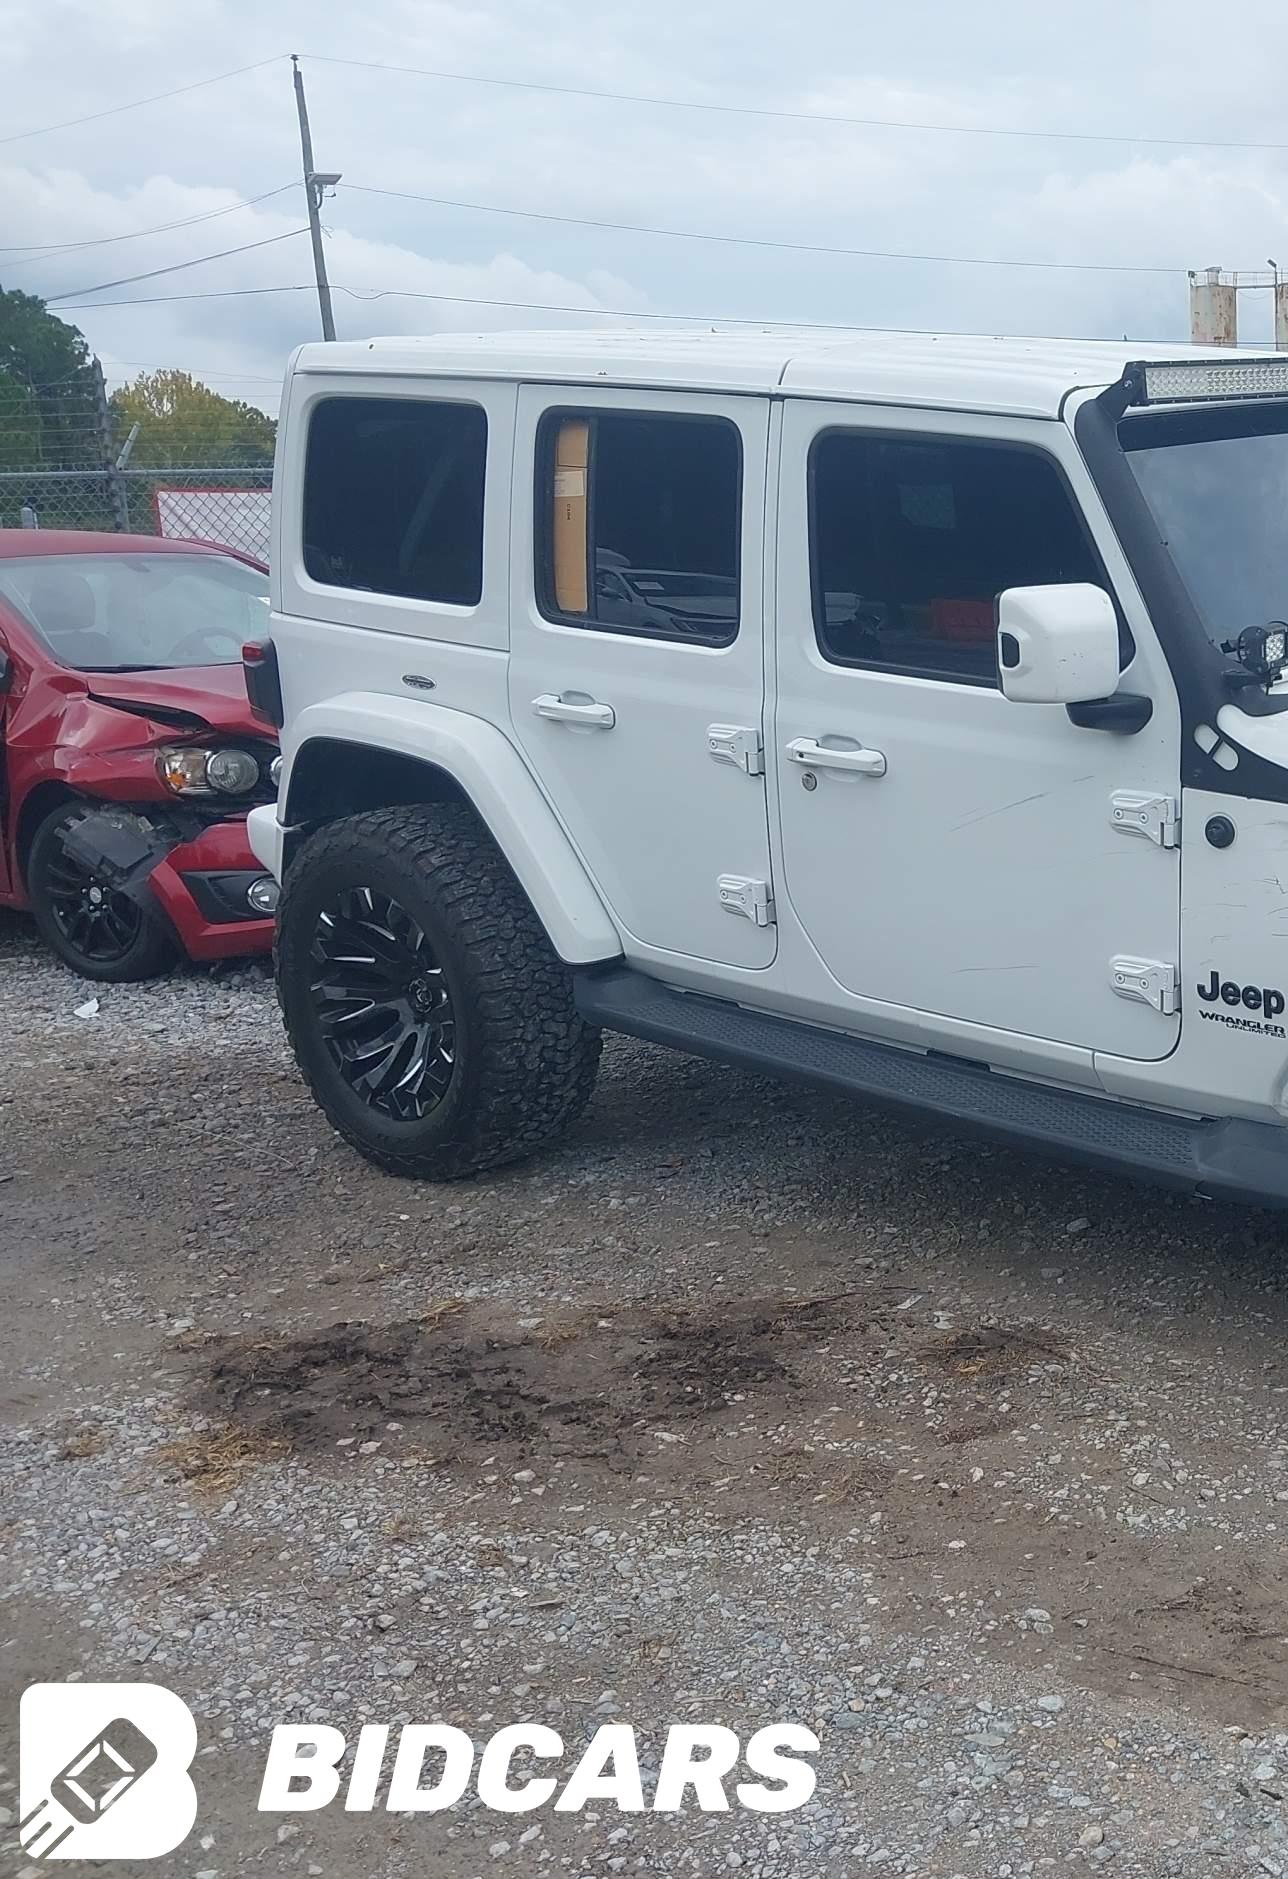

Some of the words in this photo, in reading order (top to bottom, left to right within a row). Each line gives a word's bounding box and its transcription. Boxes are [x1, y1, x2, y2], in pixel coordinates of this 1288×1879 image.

[1197, 970, 1286, 1019] Jeep
[1199, 1010, 1285, 1034] WRANGLER
[1226, 1023, 1287, 1039] UNLIMITED
